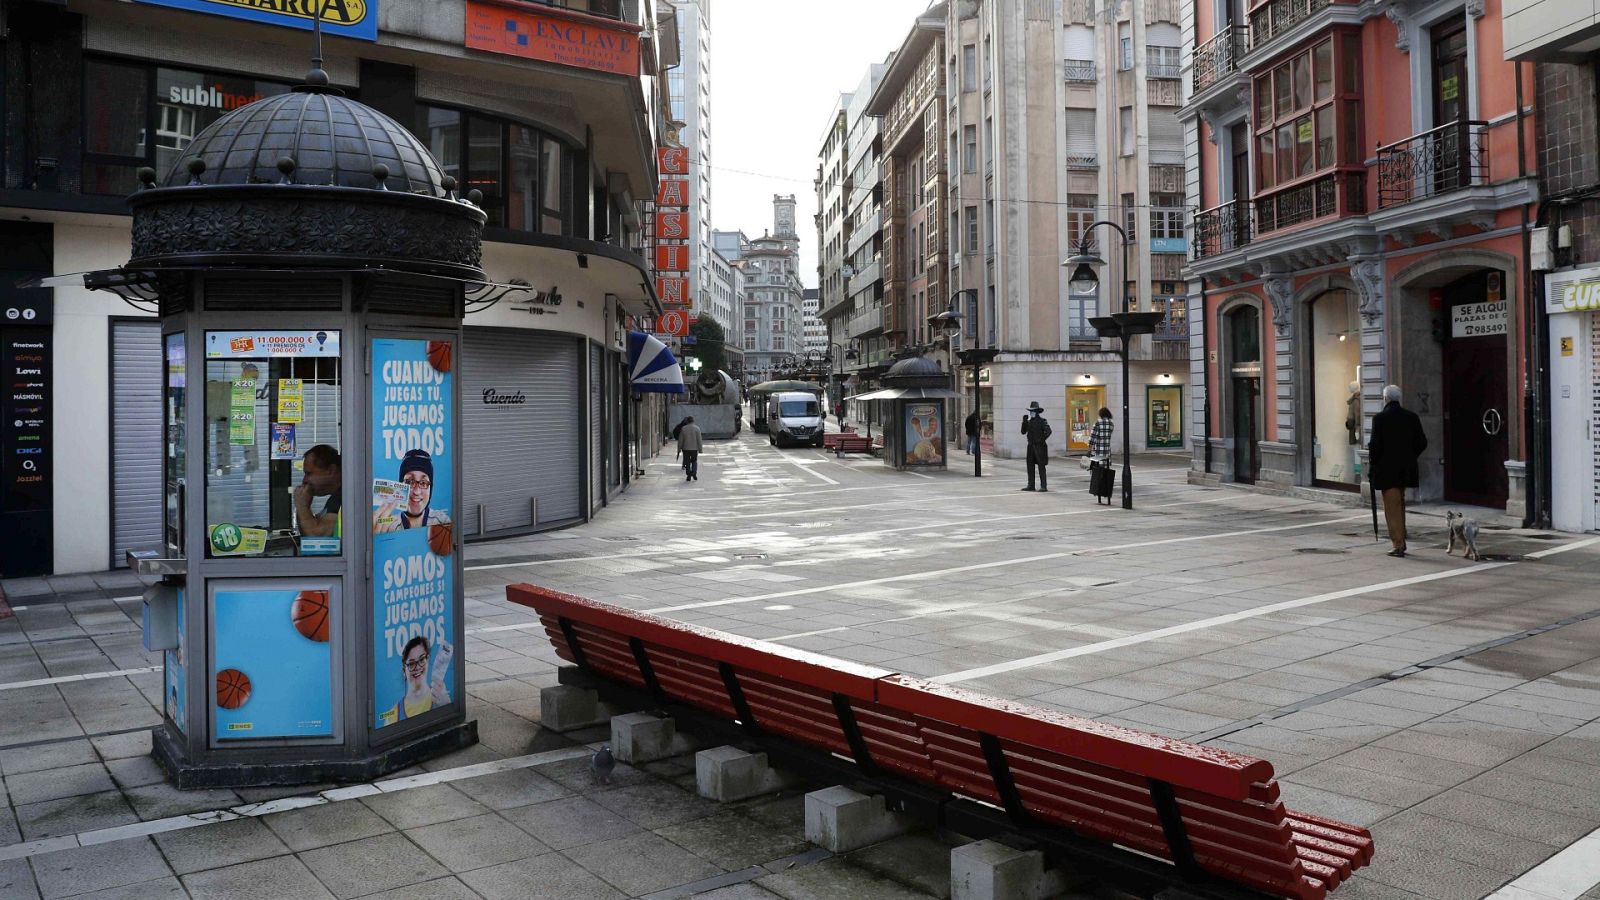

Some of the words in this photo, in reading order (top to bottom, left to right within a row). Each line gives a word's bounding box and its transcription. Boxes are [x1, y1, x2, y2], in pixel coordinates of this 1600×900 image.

[537, 20, 631, 53] ENCLAVE
[661, 149, 684, 335] CASINO
[1455, 314, 1487, 323] PLAZAS
[1461, 306, 1472, 316] SE
[384, 386, 422, 402] JUEGAS
[483, 388, 526, 404] Cuende
[382, 404, 444, 427] JUGAMOS
[382, 426, 445, 460] TODOS
[383, 551, 445, 590] SOMOS
[384, 582, 435, 604] CAMPEONES
[384, 594, 445, 628] JUGAMOS
